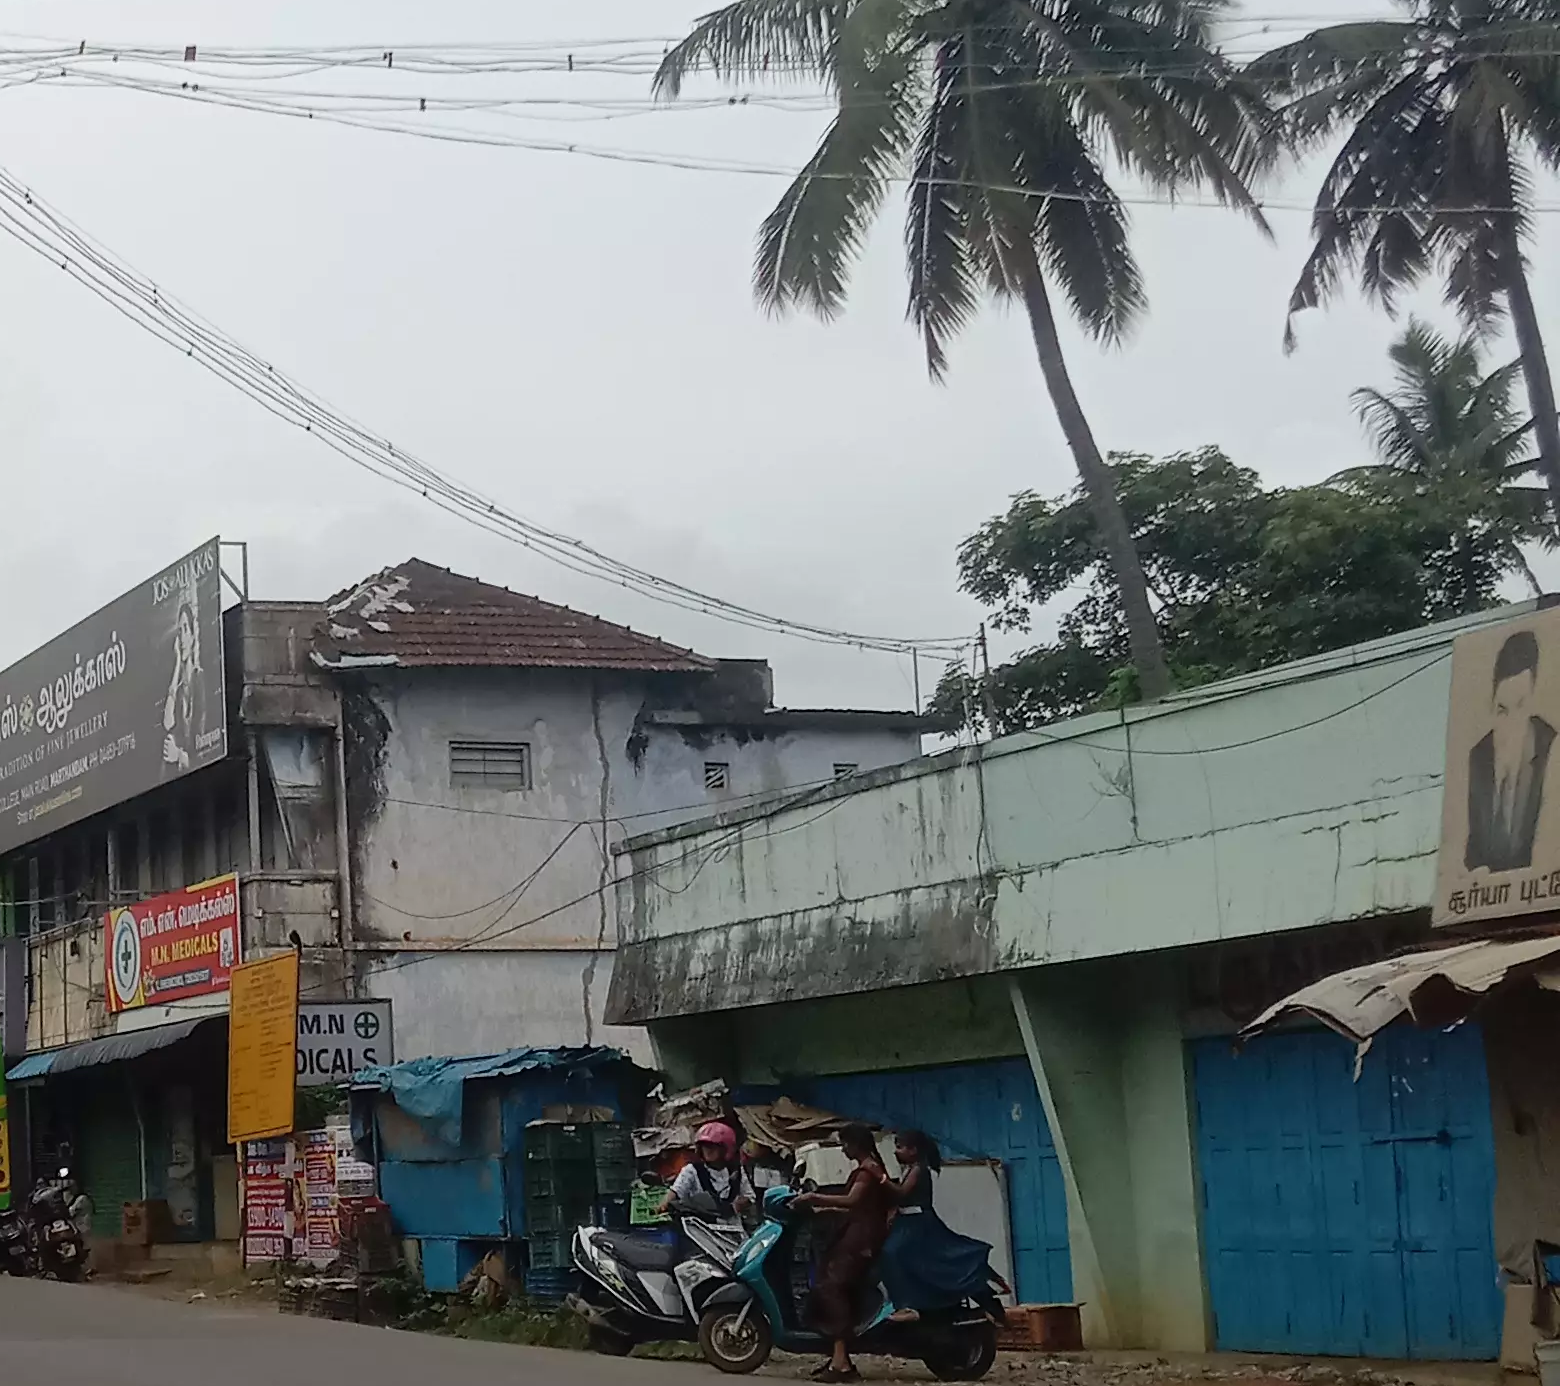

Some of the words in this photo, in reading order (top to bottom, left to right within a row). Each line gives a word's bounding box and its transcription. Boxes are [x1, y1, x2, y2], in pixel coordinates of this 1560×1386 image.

[151, 575, 170, 606] JOS
[35, 630, 127, 734] ஆலுக்காஸ்
[34, 745, 46, 764] OF
[65, 710, 109, 748] JEWELLERY
[1448, 881, 1512, 915] சூர்யா
[150, 943, 170, 966] M.N.
[171, 931, 219, 962] MEDICALS
[299, 1013, 345, 1035] M.N
[297, 1047, 378, 1075] DICALS
